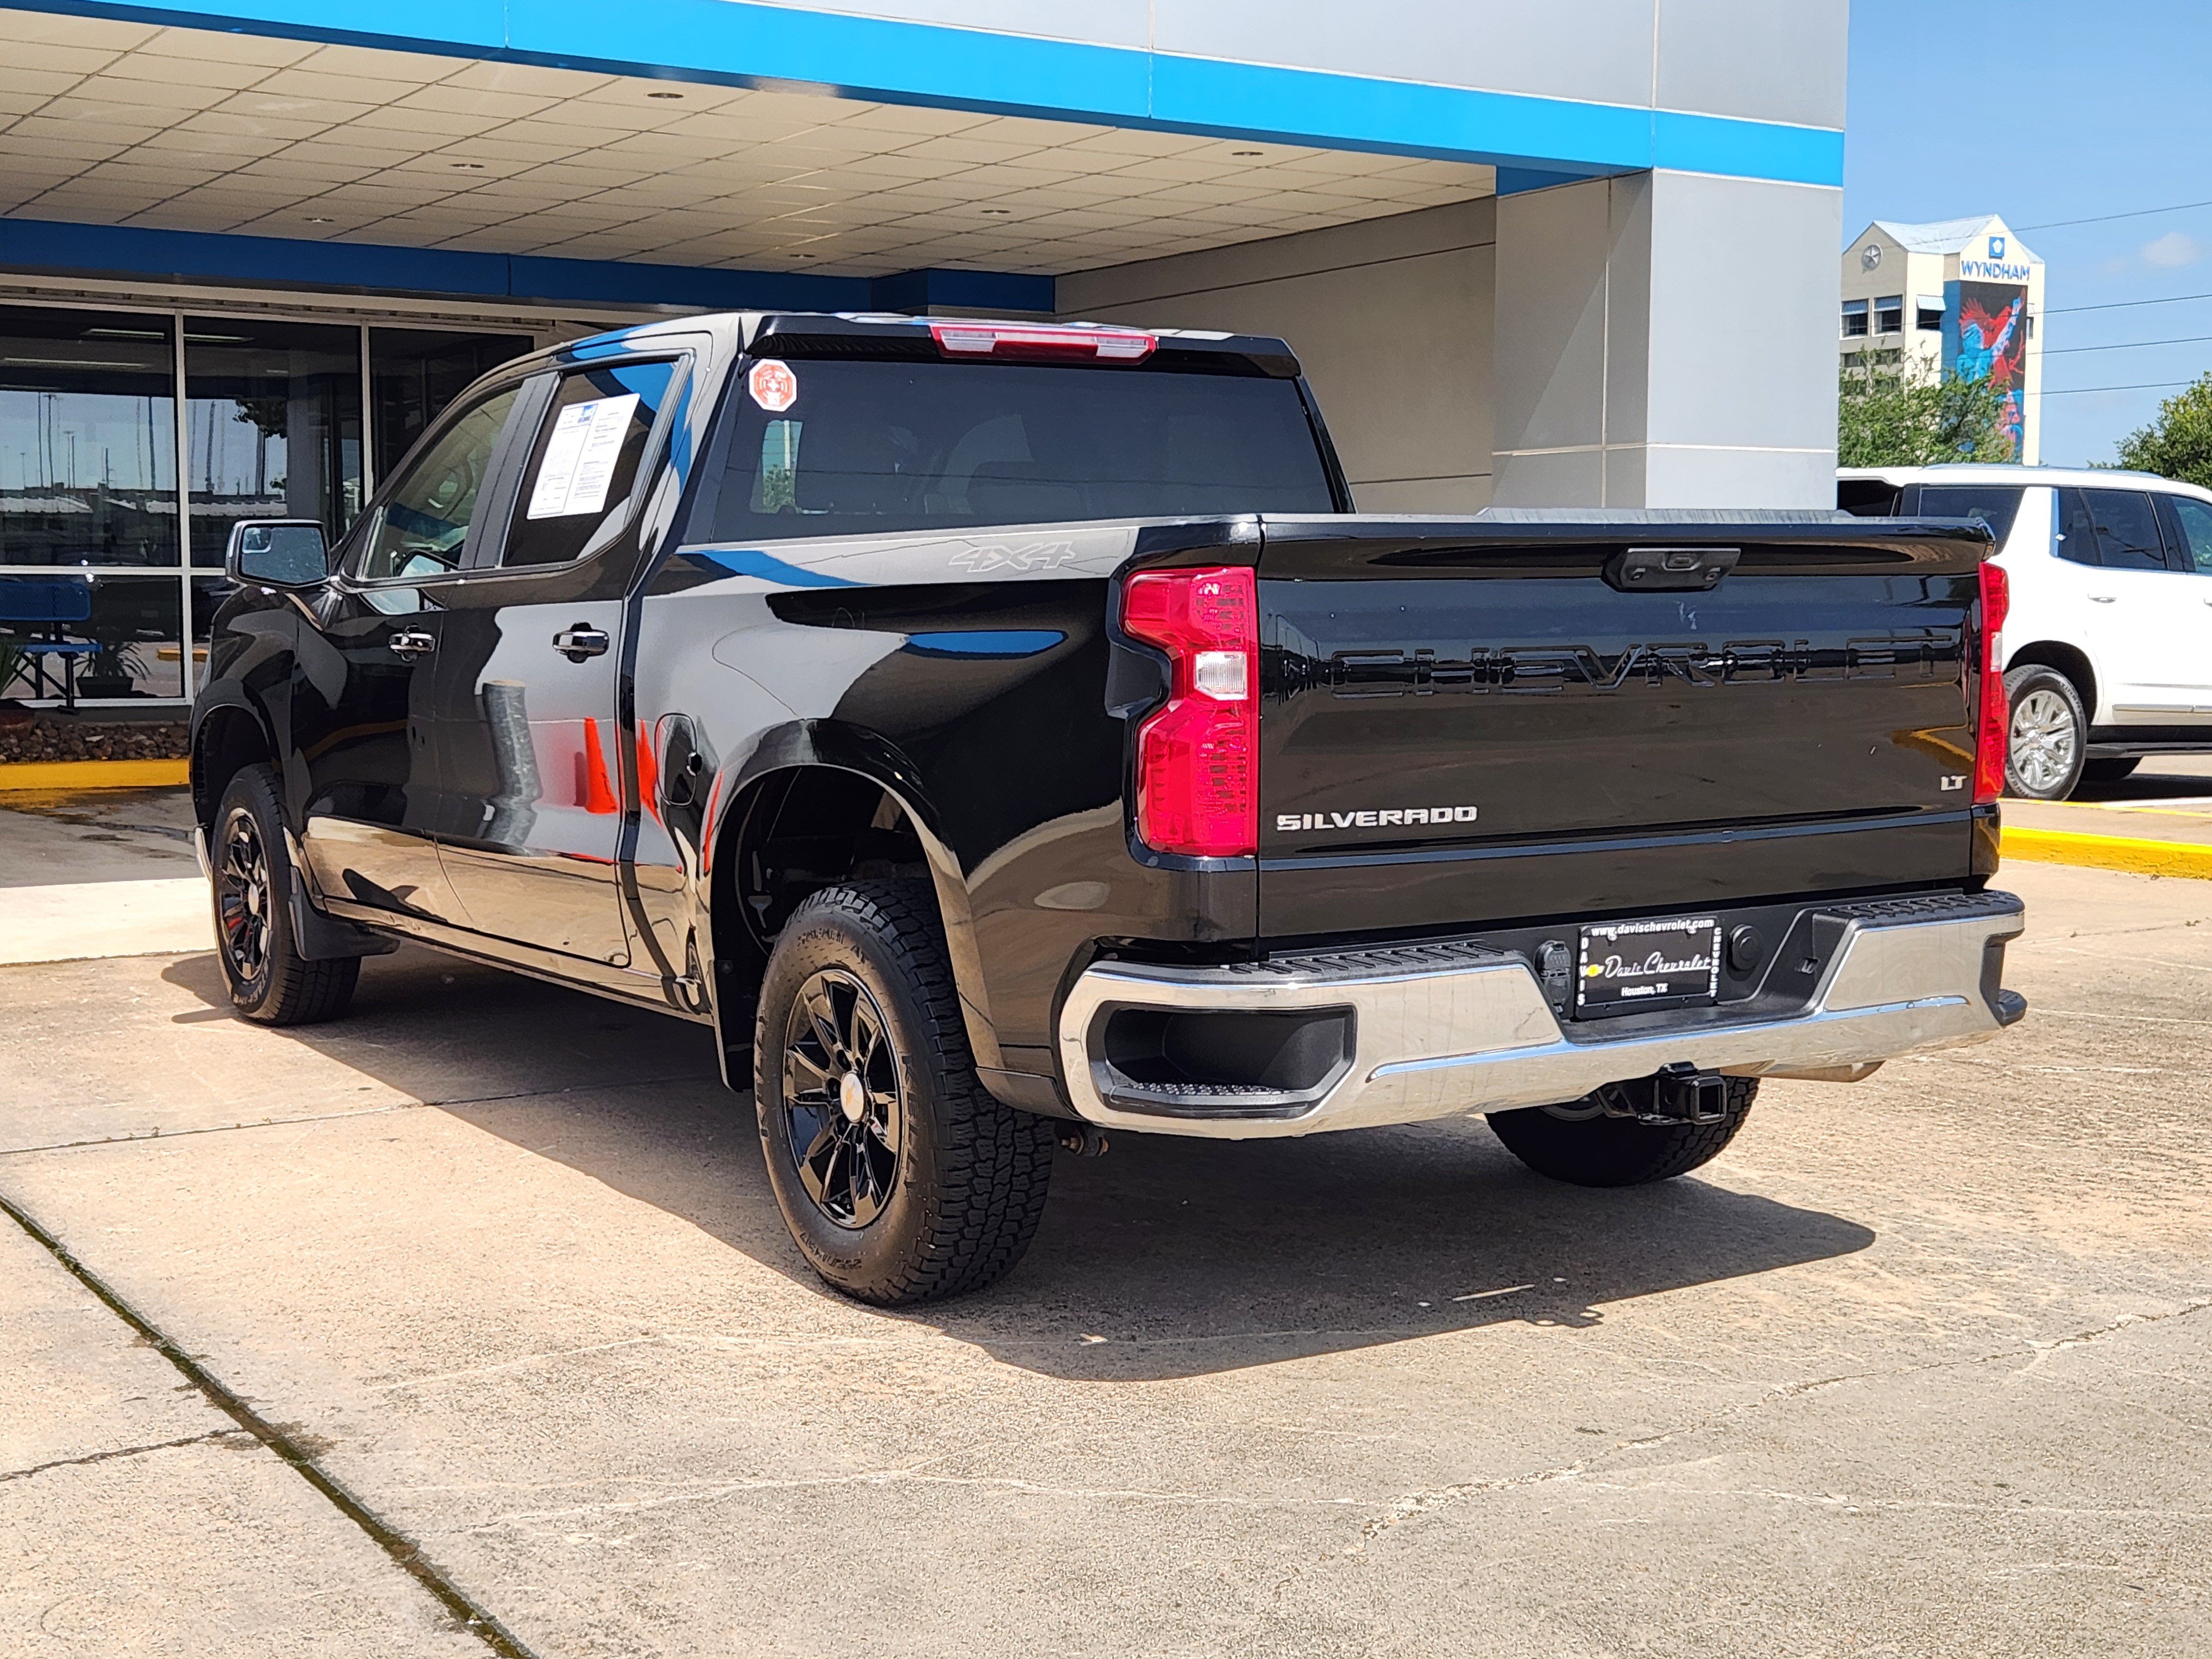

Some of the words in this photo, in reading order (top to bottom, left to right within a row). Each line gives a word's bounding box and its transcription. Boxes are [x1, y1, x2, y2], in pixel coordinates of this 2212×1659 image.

[1961, 260, 2030, 281] WYNDHAM
[948, 540, 1076, 573] 4X4
[1331, 635, 1953, 698] CHEVROLET
[1940, 775, 1968, 791] LT
[1276, 805, 1478, 831] SILVERADO
[1591, 919, 1714, 937] www.davischevrolet.com
[1577, 936, 1589, 1006] DAVIS
[1605, 954, 1644, 979] Davis
[1644, 951, 1712, 975] Chevrolet
[1709, 926, 1723, 999] CHEVROLET
[1655, 982, 1669, 994] TX
